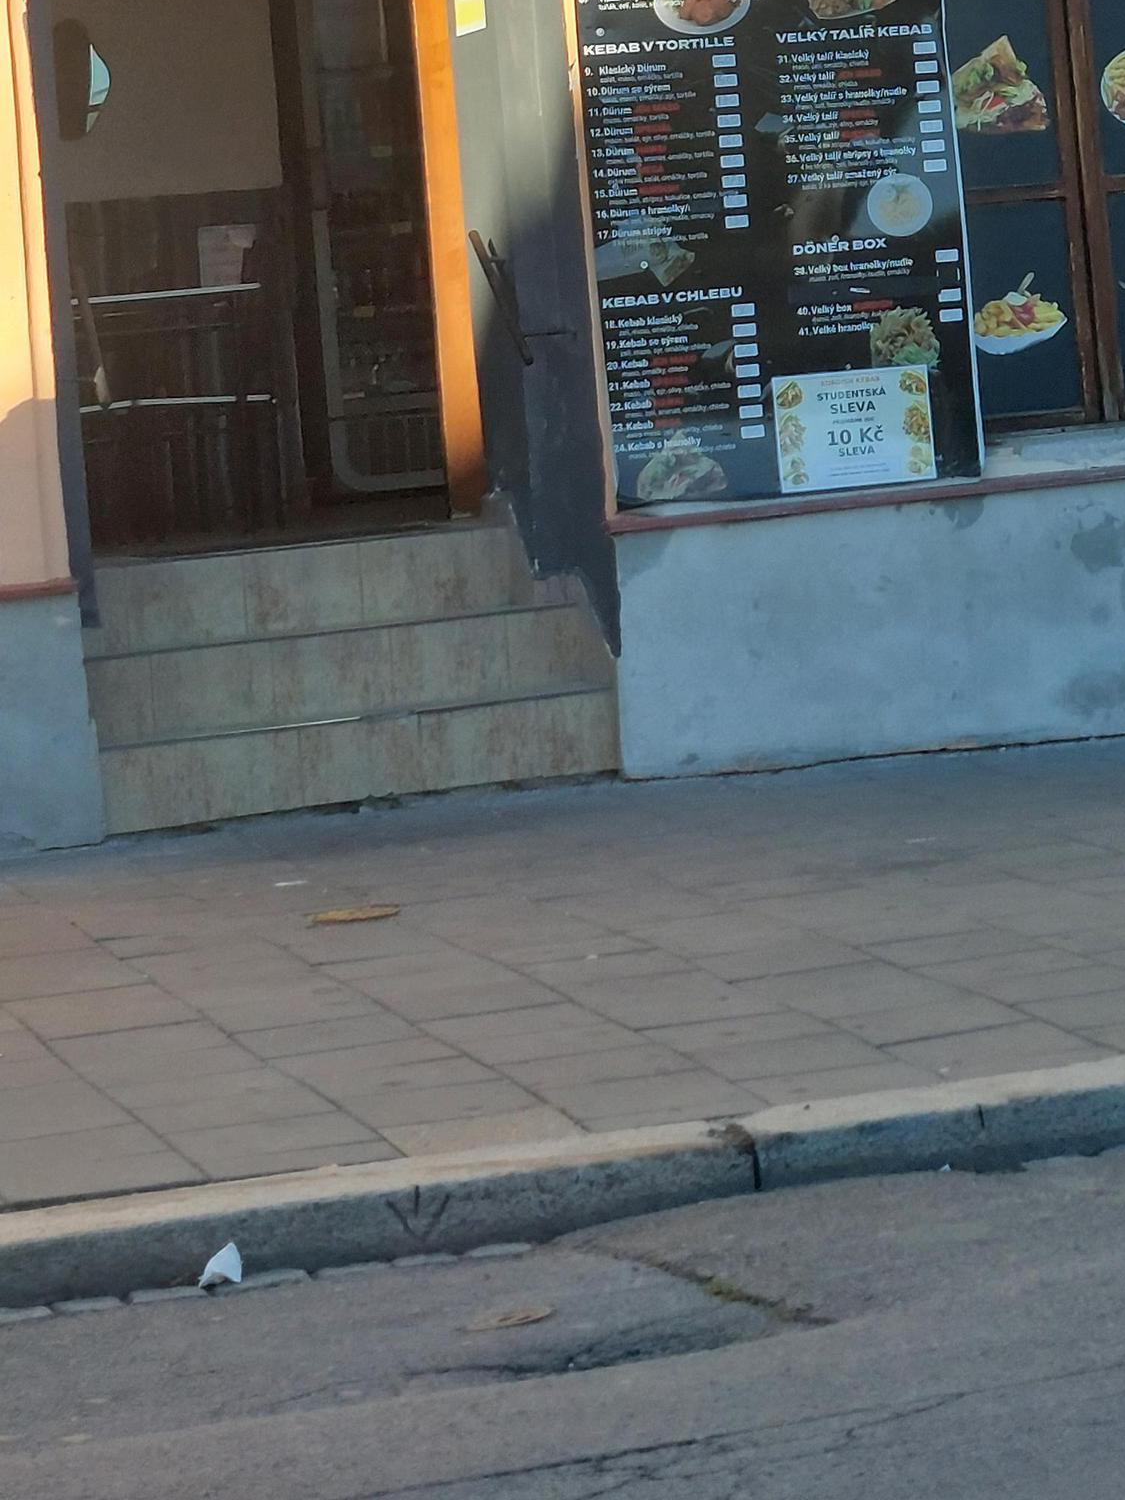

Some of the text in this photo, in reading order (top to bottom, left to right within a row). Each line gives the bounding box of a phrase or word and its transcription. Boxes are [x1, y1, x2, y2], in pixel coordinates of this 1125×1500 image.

[776, 24, 932, 44] VELKÝ TALÍŘ KEBAB
[583, 36, 735, 56] KEBAB V TORTILLE
[793, 238, 887, 255] DÖNER BOX
[602, 286, 742, 309] KEBAB V CHLEBU
[816, 386, 886, 402] STUDENTSKÁ
[830, 400, 876, 415] SLEVA
[828, 425, 885, 446] 10 Kč
[838, 445, 876, 457] SLEVA
